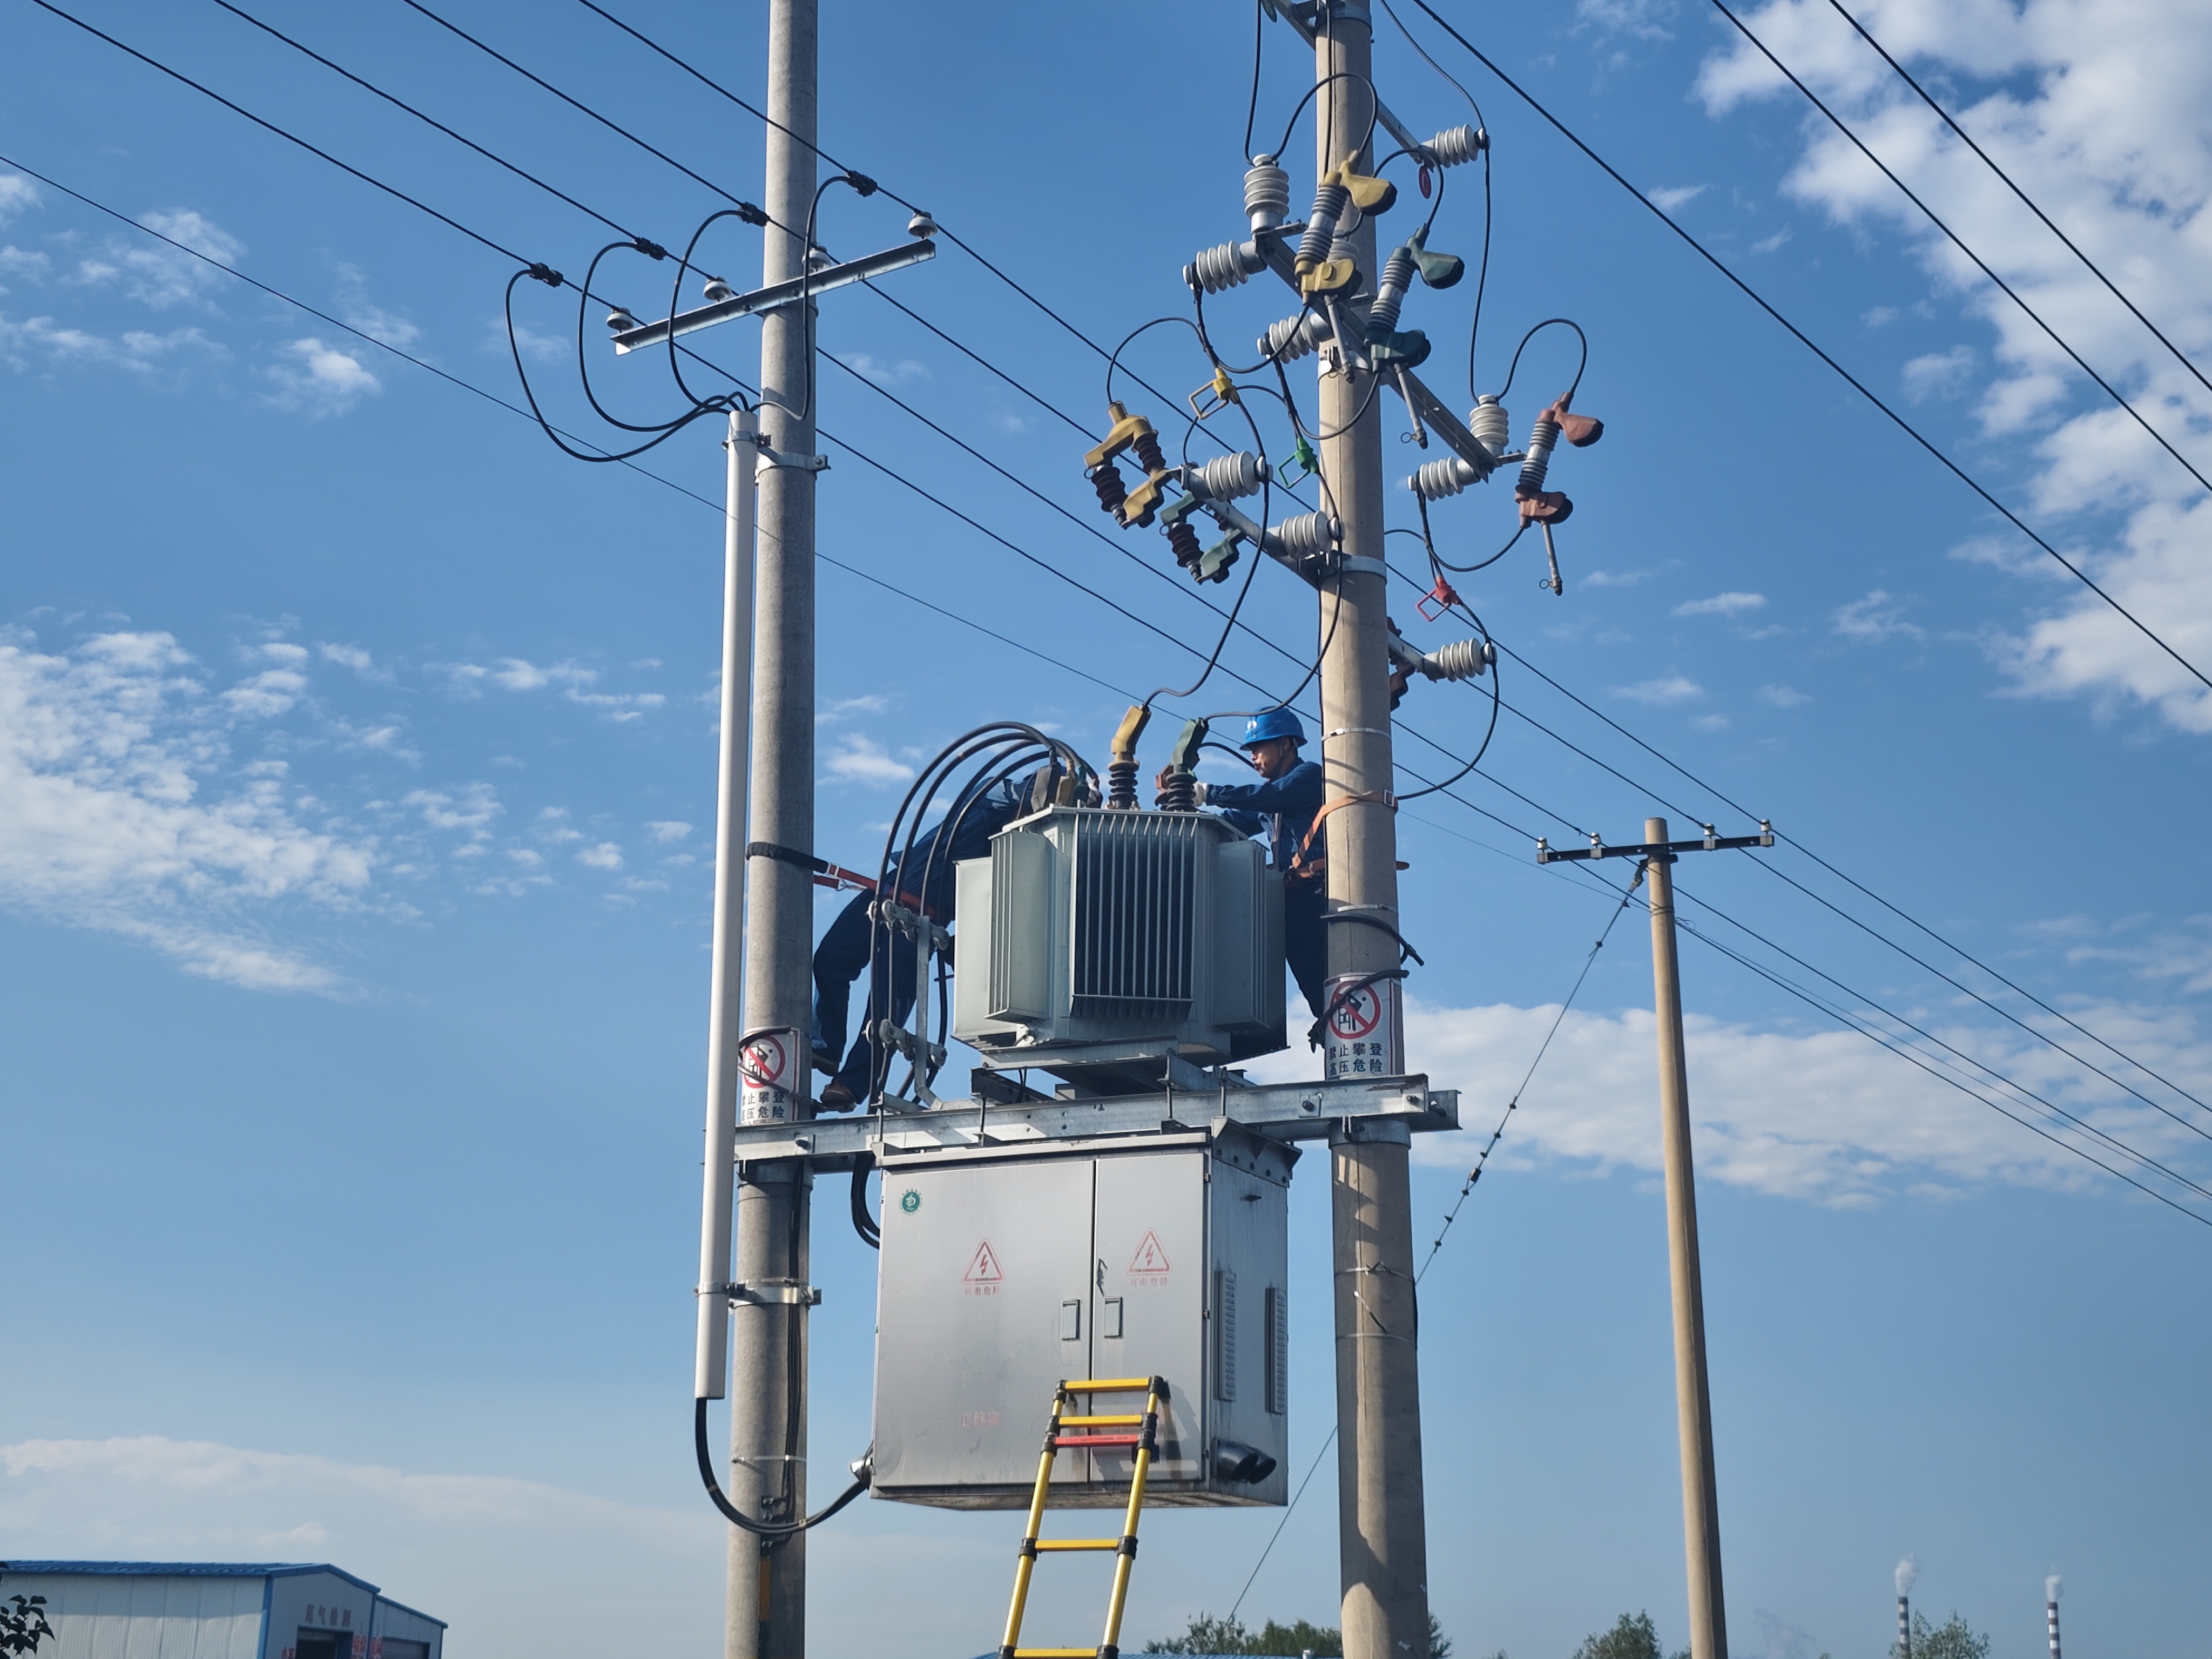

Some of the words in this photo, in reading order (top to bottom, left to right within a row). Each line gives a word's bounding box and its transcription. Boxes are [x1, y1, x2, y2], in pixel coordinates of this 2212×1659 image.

[1329, 1042, 1382, 1060] 禁止攀登
[1329, 1058, 1382, 1076] 高压危险
